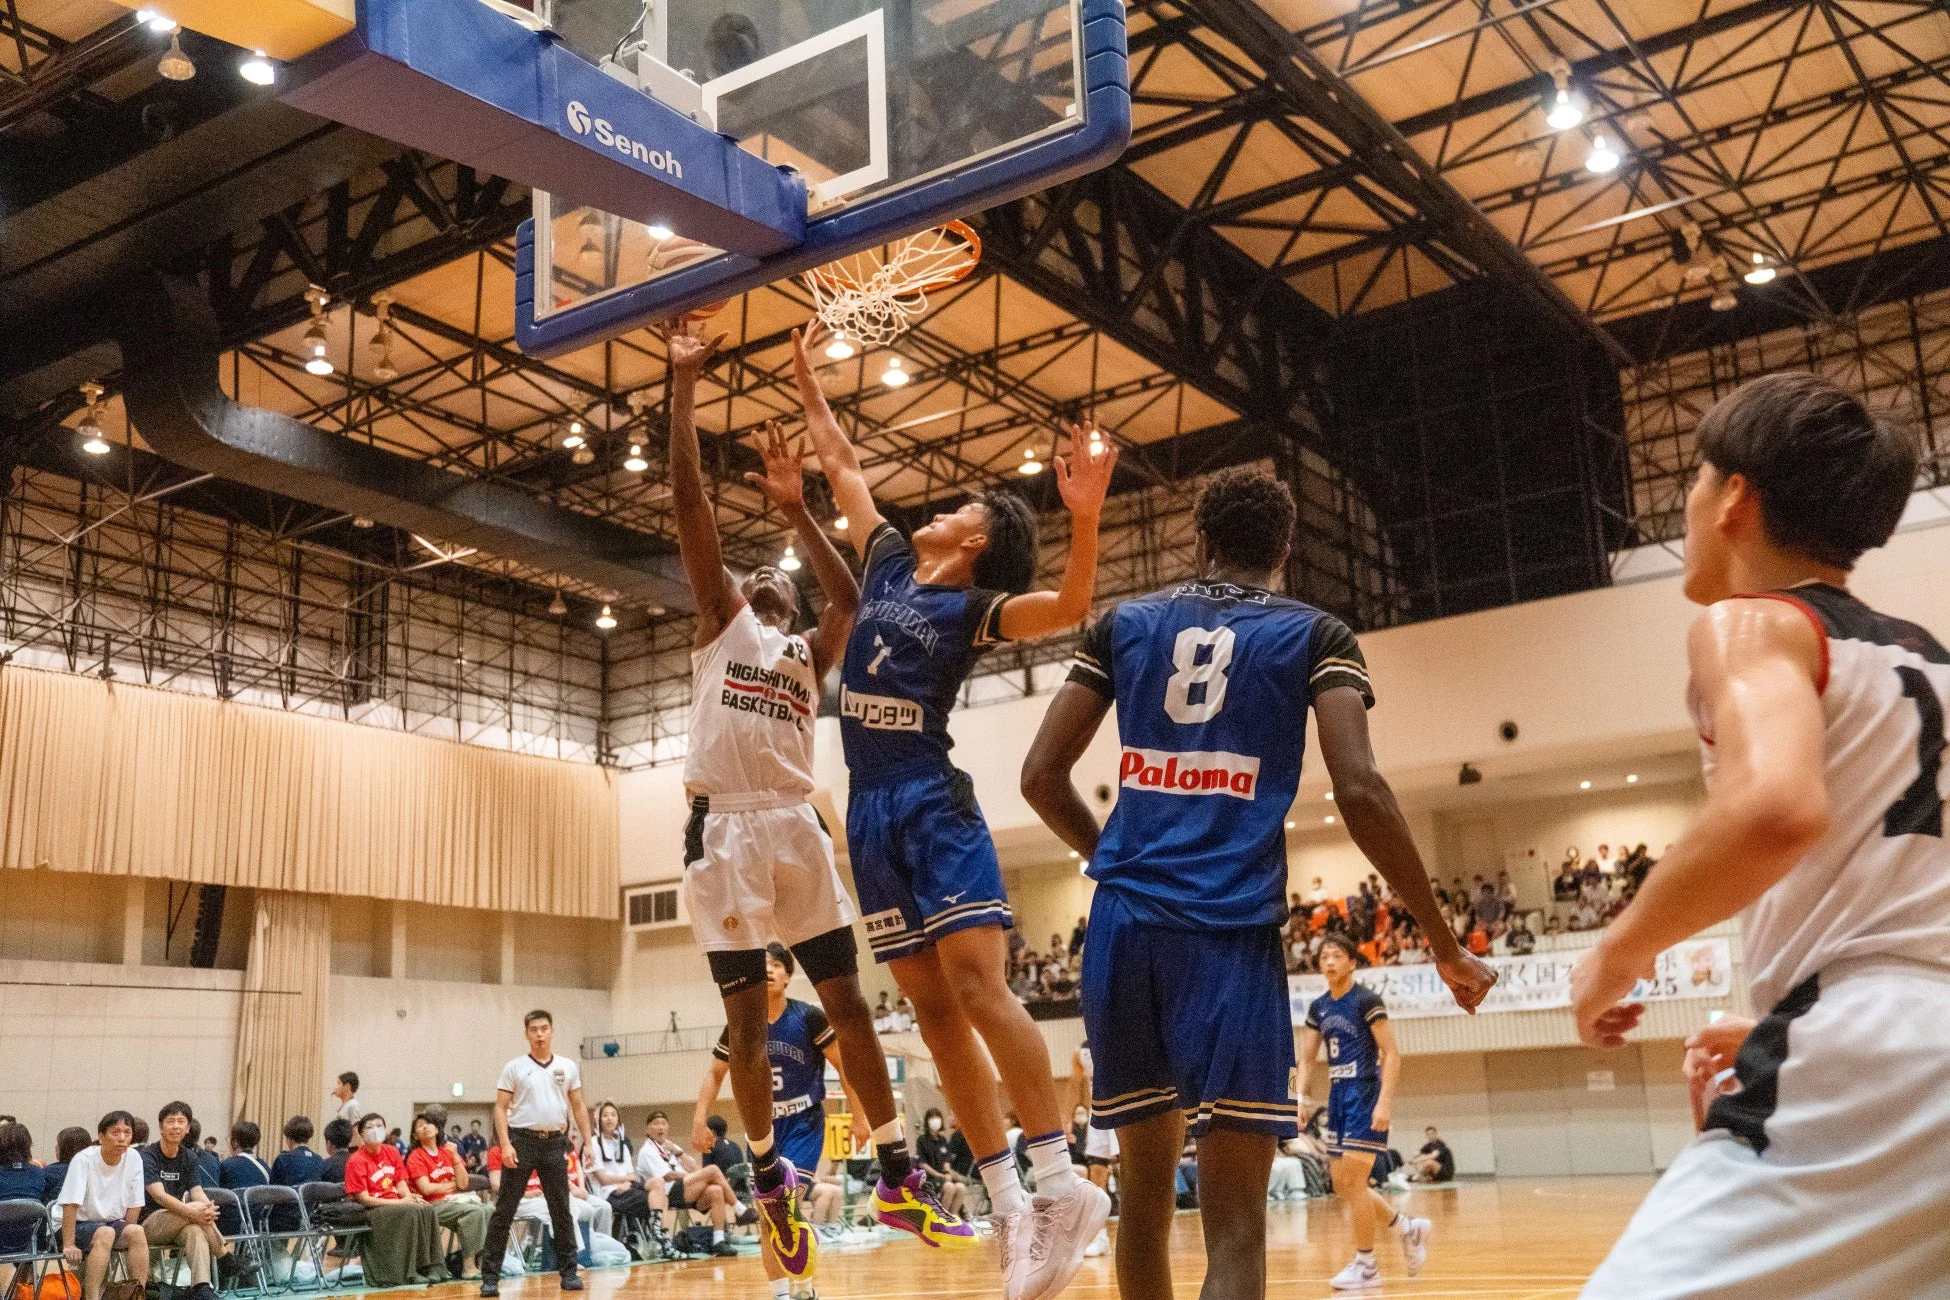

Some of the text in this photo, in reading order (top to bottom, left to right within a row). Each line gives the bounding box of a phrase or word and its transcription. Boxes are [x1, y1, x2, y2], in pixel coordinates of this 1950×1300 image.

[594, 118, 683, 180] Senoh
[1164, 626, 1236, 725] 8
[1120, 752, 1254, 795] Paloma
[1883, 664, 1946, 838] 2
[1328, 1036, 1340, 1059] 6
